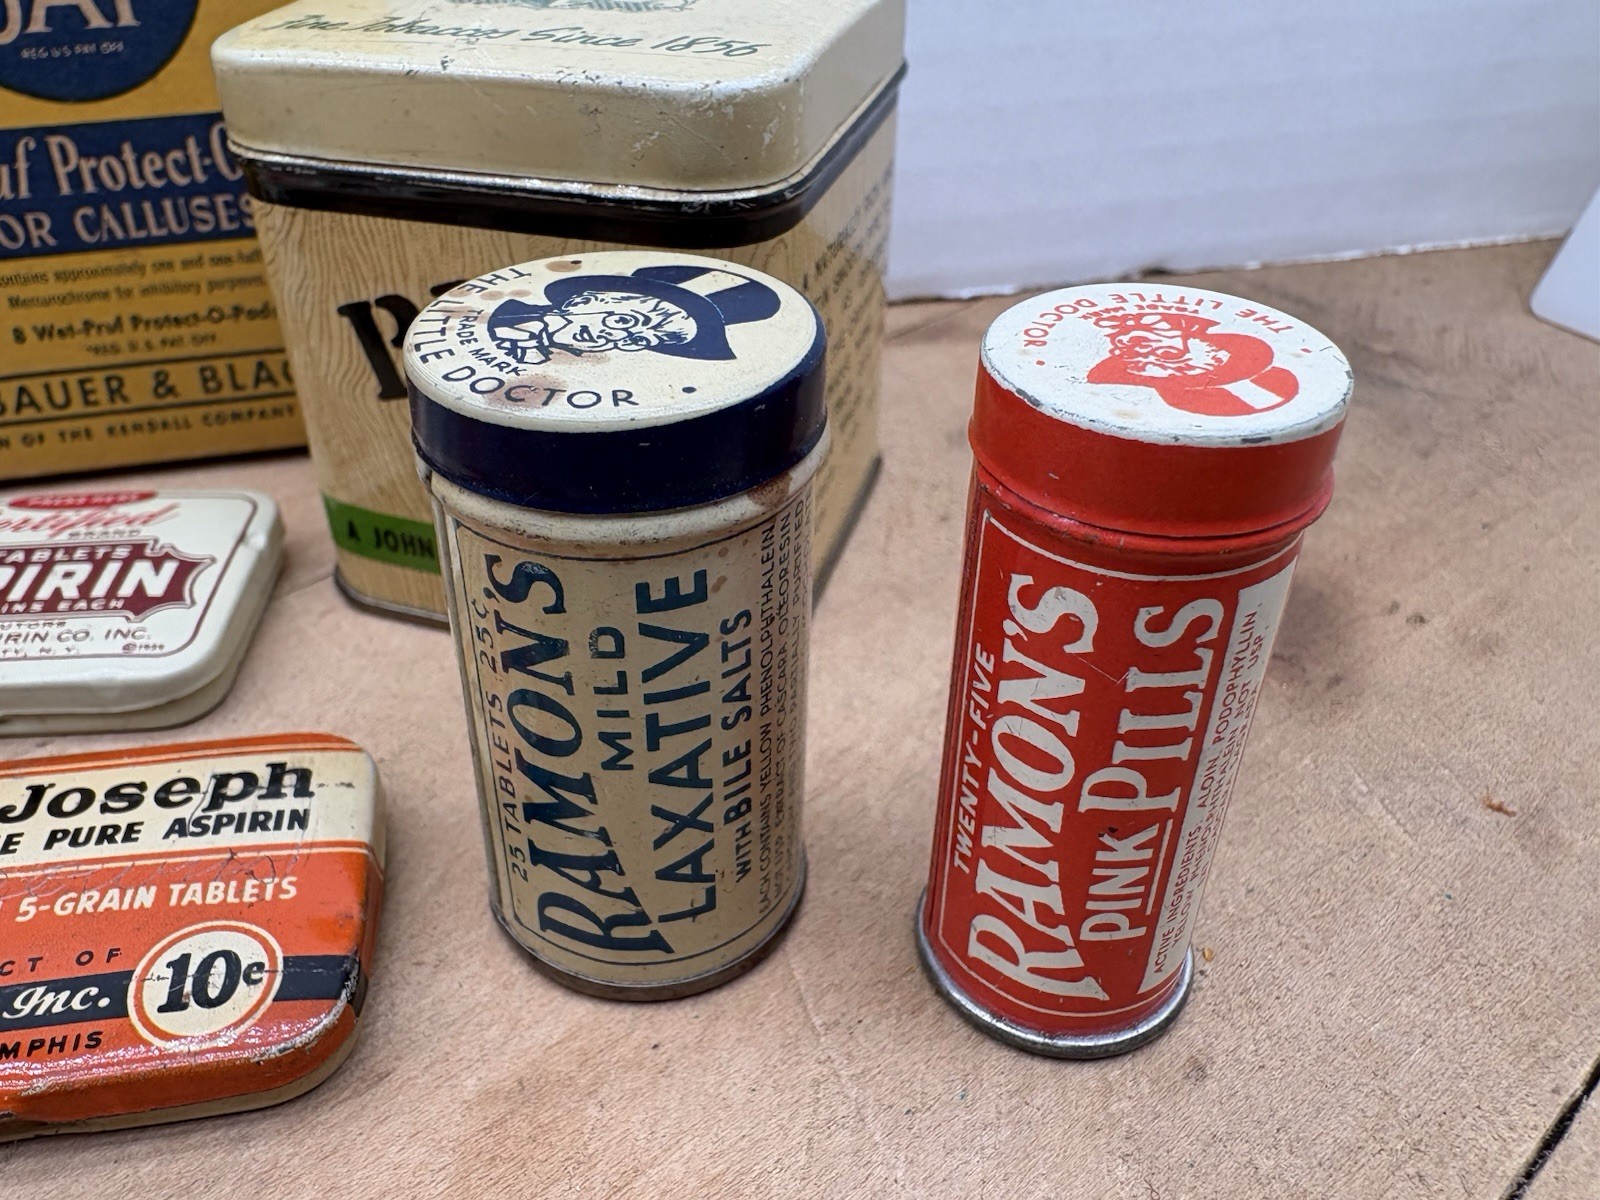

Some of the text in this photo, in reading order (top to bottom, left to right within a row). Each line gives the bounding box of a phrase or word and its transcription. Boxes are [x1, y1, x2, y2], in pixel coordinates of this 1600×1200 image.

[521, 26, 644, 47] Since
[651, 35, 772, 57] 1856
[413, 267, 640, 410] THE LITTLE DOCTOR
[455, 308, 528, 377] TRADE MARK
[1023, 292, 1294, 348] THE LITTLE DOCTOR
[0, 374, 130, 415] AUER
[153, 369, 179, 399] &
[57, 599, 126, 613] EACH
[760, 522, 775, 717] PHENOLPHTHALEIN
[588, 626, 634, 771] MILD
[1078, 598, 1224, 813] PILLS
[482, 553, 675, 954] RAMON'S
[485, 691, 521, 834] TABLETS
[635, 569, 716, 924] LAXATIVE
[720, 609, 752, 883] WITH BILE SALTS
[760, 722, 772, 793] YELLOW
[954, 642, 996, 874] TWENTY-FIVE
[0, 761, 315, 824] Joseph
[967, 573, 1110, 1001] RAMON'S
[43, 821, 144, 850] PURE
[162, 808, 310, 840] ASPIRIN
[509, 843, 529, 883] 25
[15, 885, 157, 922] 5-GRAIN
[169, 876, 298, 908] TABLETS
[1079, 822, 1159, 942] PINK
[76, 948, 122, 967] OF
[1154, 925, 1175, 974] ACTIVE
[2, 985, 111, 1020] Inc.
